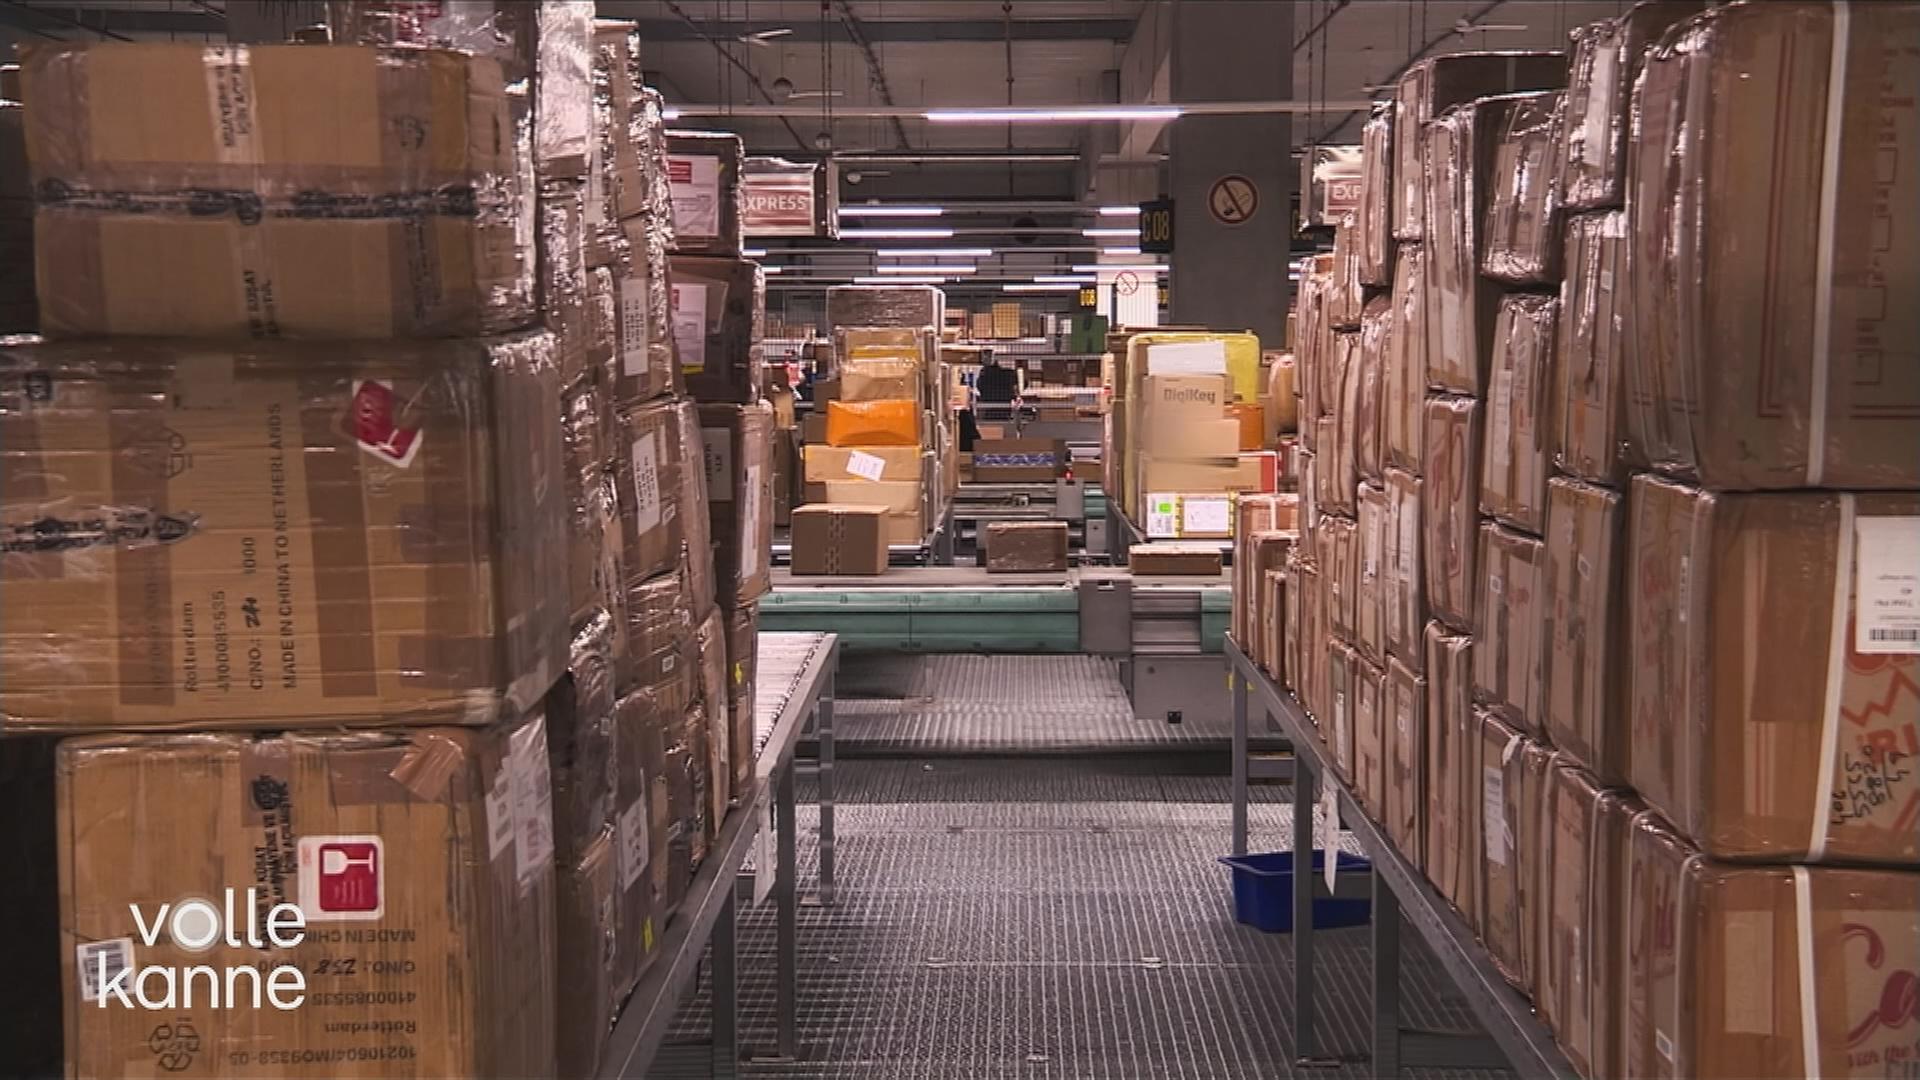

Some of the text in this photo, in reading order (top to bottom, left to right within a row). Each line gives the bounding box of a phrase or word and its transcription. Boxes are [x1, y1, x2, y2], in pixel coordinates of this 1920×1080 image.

[1164, 388, 1216, 404] DigiKey
[269, 402, 297, 689] MADE IN CHINA TO NETHERLANDS
[183, 600, 198, 692] Rotterdam
[346, 930, 362, 943] IN
[367, 929, 416, 942] MADE
[325, 1020, 416, 1034] Rotterdam
